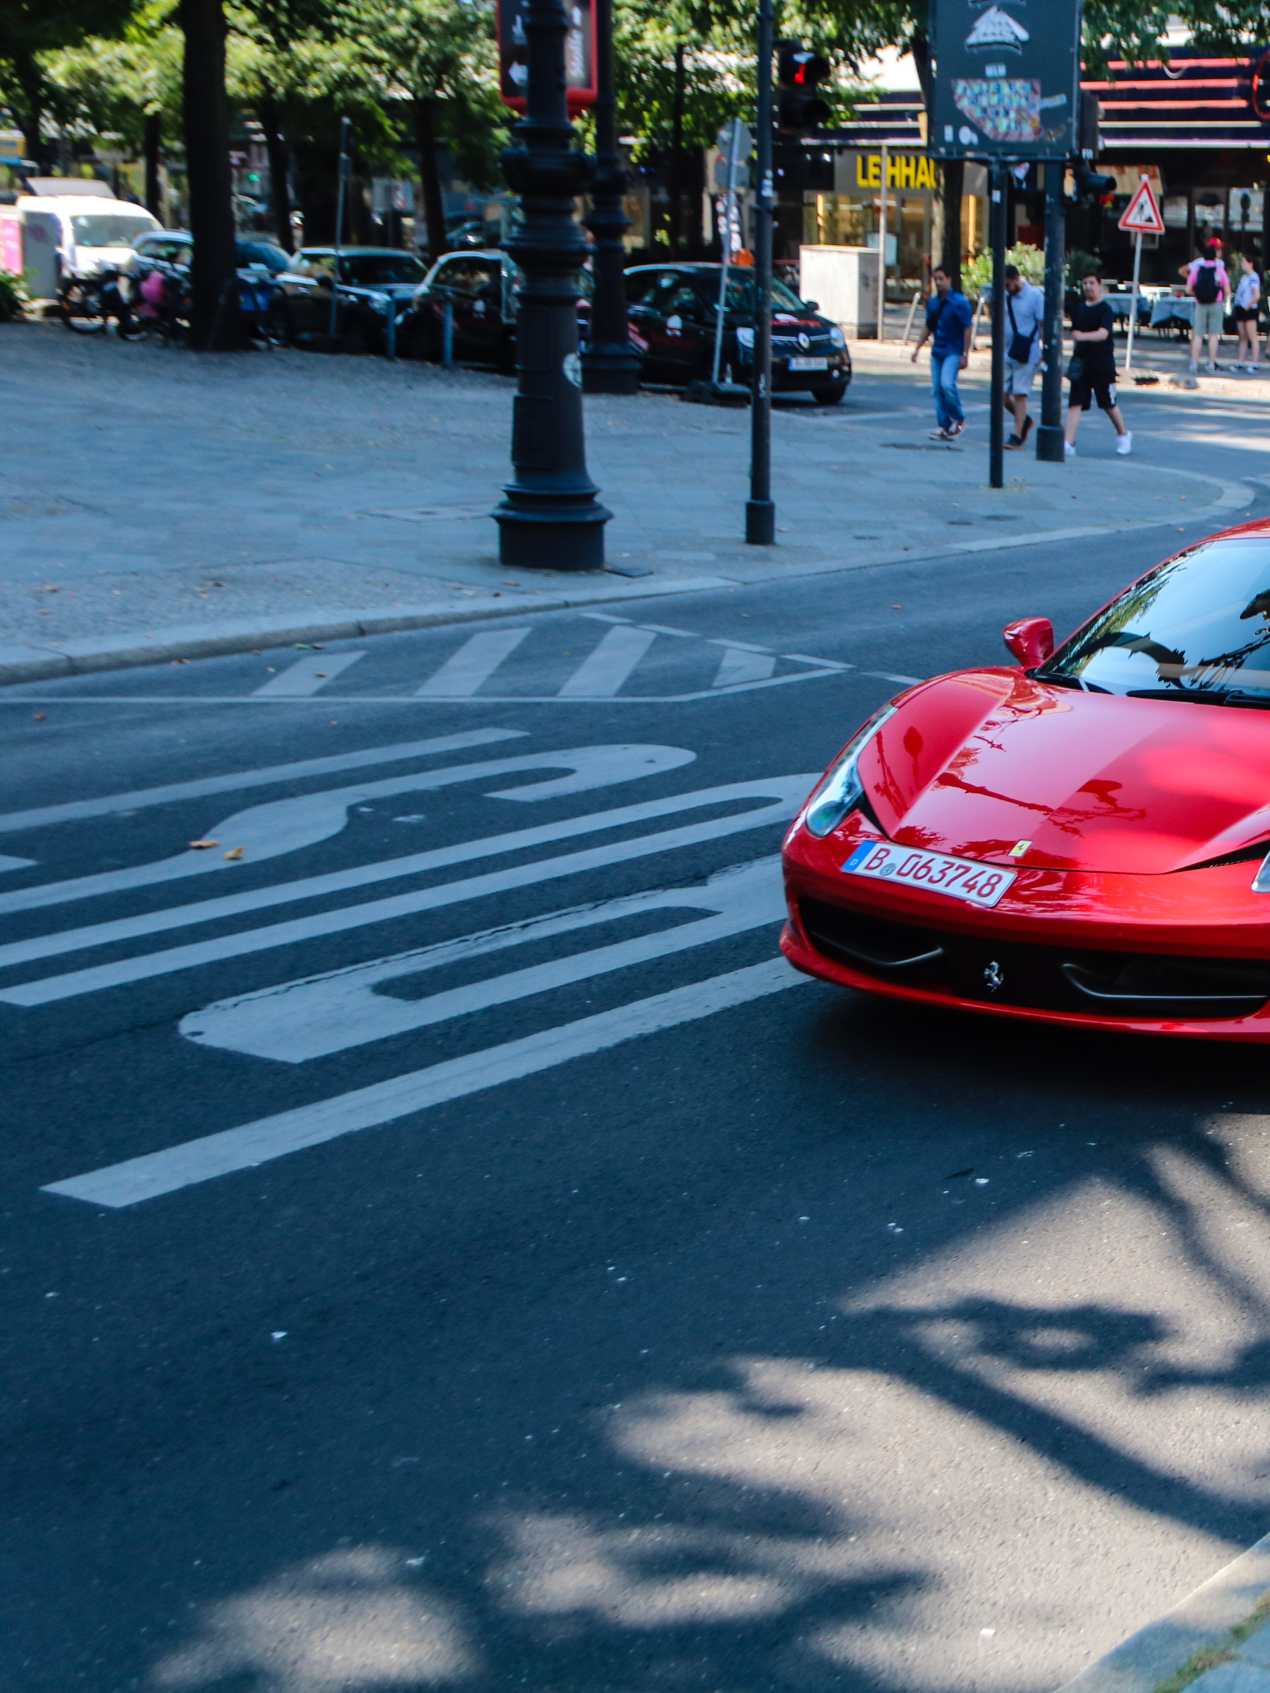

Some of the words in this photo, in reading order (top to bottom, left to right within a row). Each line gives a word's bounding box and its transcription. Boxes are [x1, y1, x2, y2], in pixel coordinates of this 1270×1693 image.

[857, 154, 937, 189] LEHHA
[864, 847, 891, 872] B
[896, 853, 1003, 899] 063748
